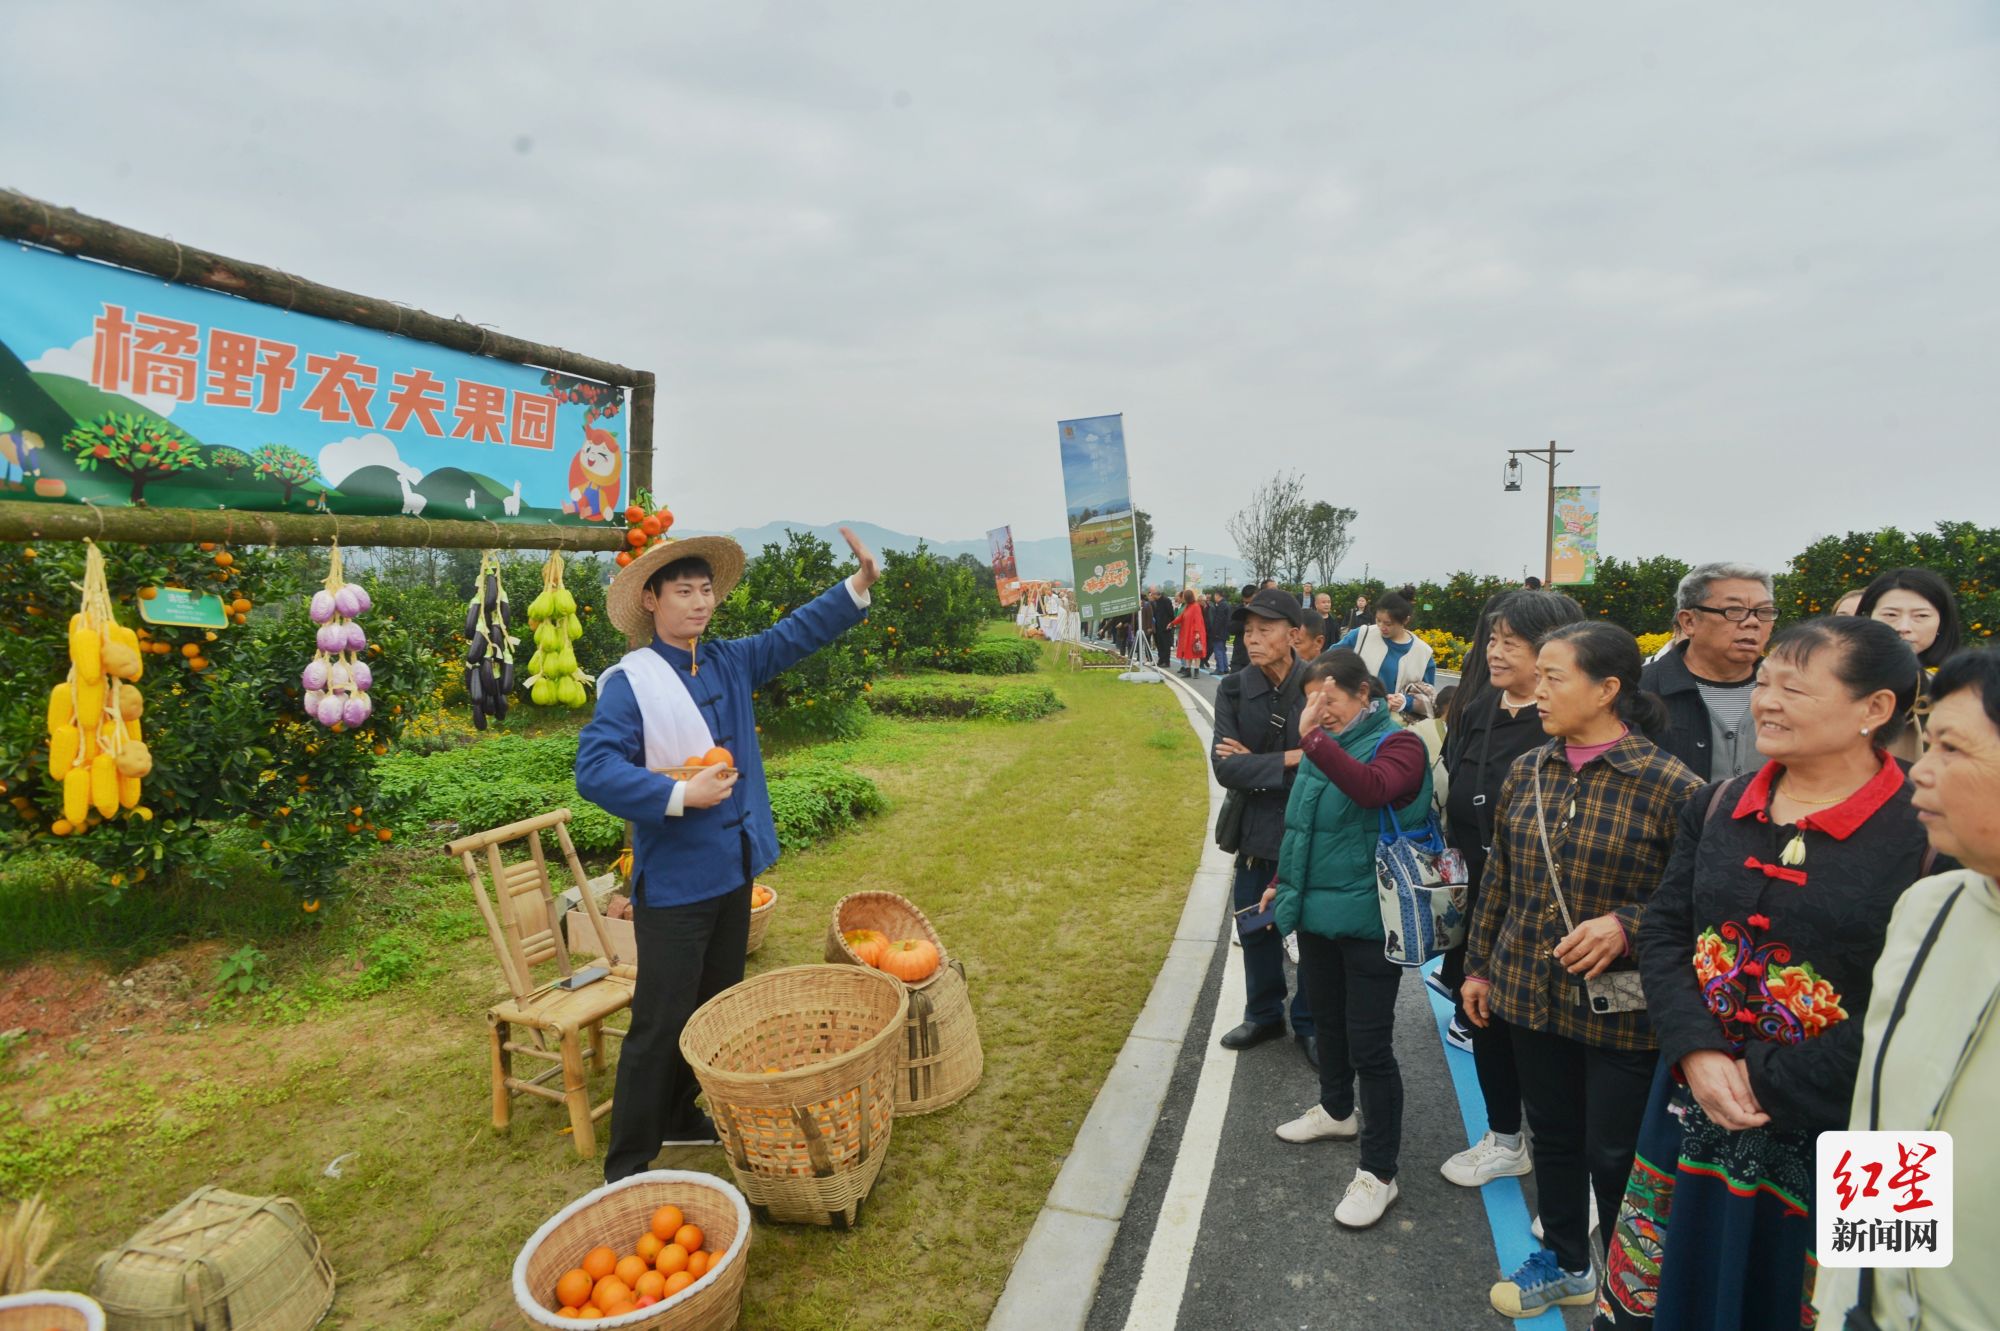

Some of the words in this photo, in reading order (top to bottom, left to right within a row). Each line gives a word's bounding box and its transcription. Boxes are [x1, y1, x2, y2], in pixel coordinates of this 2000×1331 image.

[92, 302, 558, 451] 橘野农夫果园
